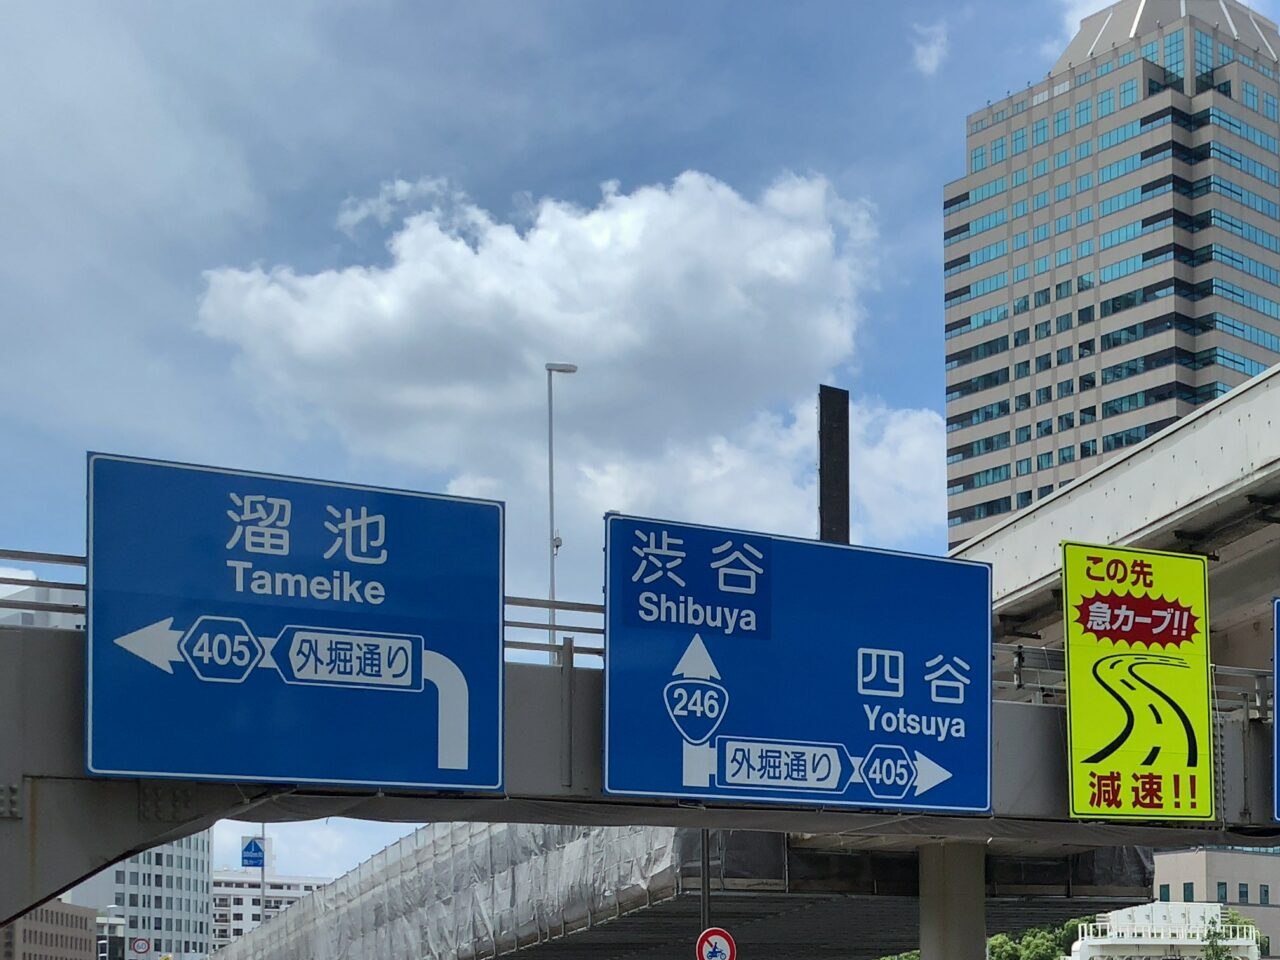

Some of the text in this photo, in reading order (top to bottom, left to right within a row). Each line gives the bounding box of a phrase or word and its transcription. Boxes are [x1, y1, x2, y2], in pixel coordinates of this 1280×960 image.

[226, 492, 388, 565] 溜池
[631, 529, 764, 595] 渋谷
[1085, 556, 1154, 588] この先
[226, 560, 386, 605] Tameike
[638, 592, 757, 635] Shibuya
[1087, 602, 1189, 637] 急カーブ!!
[192, 633, 251, 666] 405
[295, 642, 410, 679] 外堀通り
[857, 646, 971, 705] 四谷
[672, 688, 719, 718] 246
[863, 704, 966, 742] Yotsuya
[730, 747, 832, 783] 外堀通り
[868, 757, 909, 786] 405
